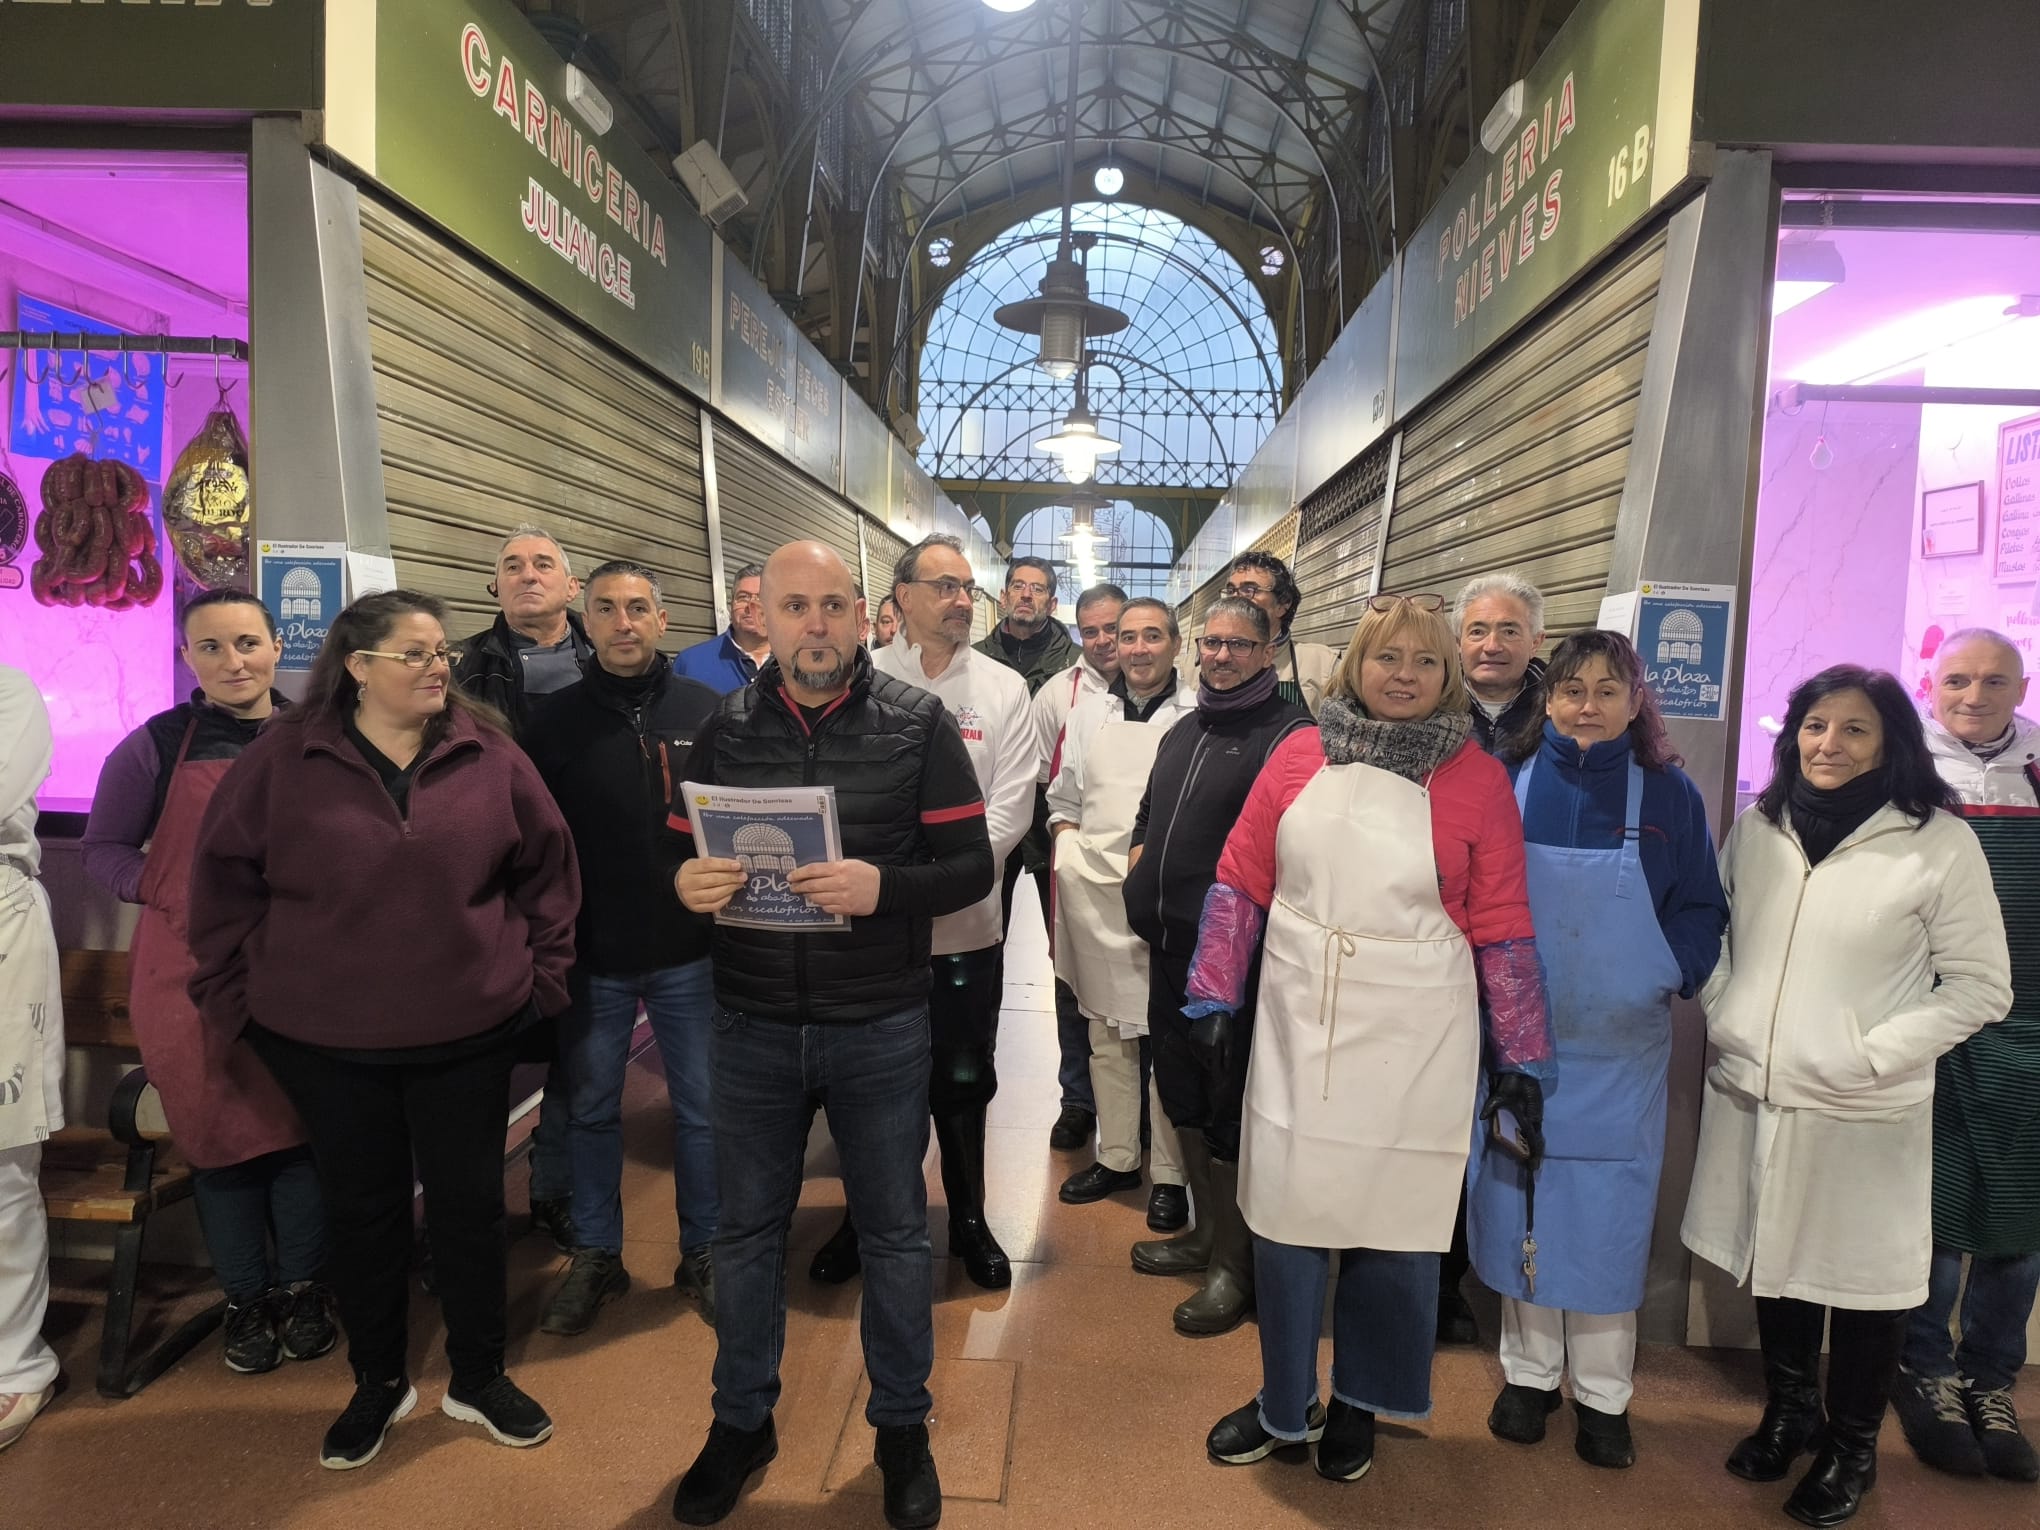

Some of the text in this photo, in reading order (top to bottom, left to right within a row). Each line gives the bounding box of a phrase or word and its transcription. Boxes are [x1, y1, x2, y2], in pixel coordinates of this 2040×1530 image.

[461, 22, 667, 267] CARNICERIA
[1437, 71, 1576, 283] POLLERIA
[521, 176, 597, 283] JULIAN
[1454, 169, 1563, 329] NIEVES
[1662, 663, 1711, 686] Plaza
